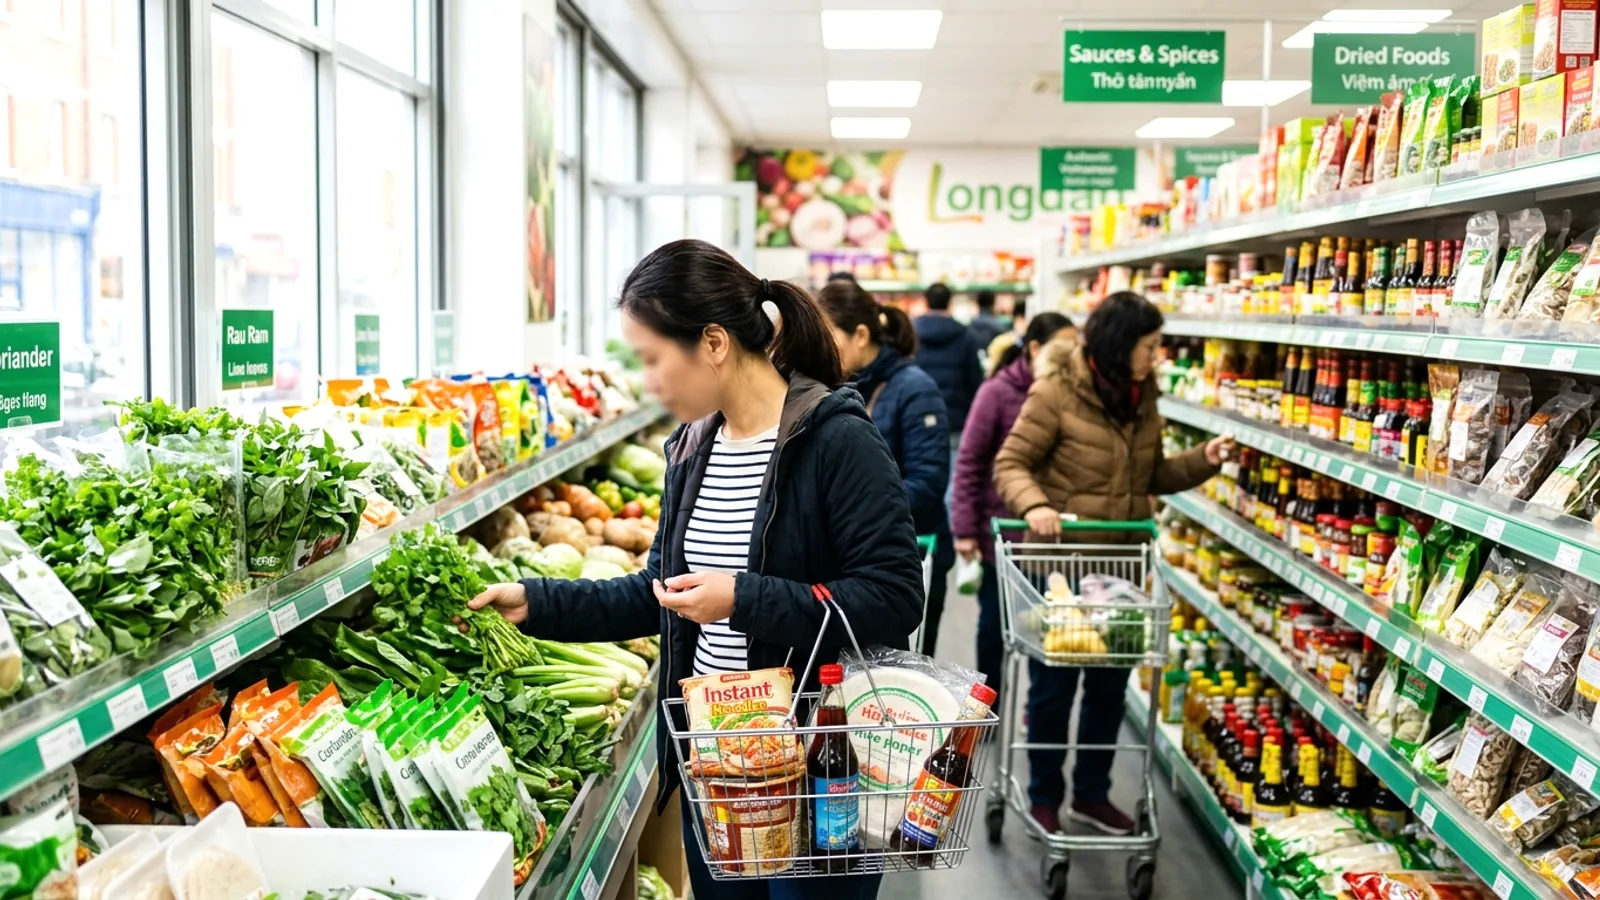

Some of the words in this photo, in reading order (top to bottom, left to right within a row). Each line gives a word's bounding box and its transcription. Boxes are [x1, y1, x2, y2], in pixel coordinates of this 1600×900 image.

[1069, 44, 1136, 63] Sauces
[1138, 45, 1154, 63] &
[1158, 45, 1219, 68] Spices
[1335, 46, 1387, 65] Dried
[1393, 46, 1450, 65] Foods
[227, 326, 246, 345] Rau
[248, 325, 269, 344] Ram
[0, 345, 54, 370] riander
[704, 681, 773, 703] Instant
